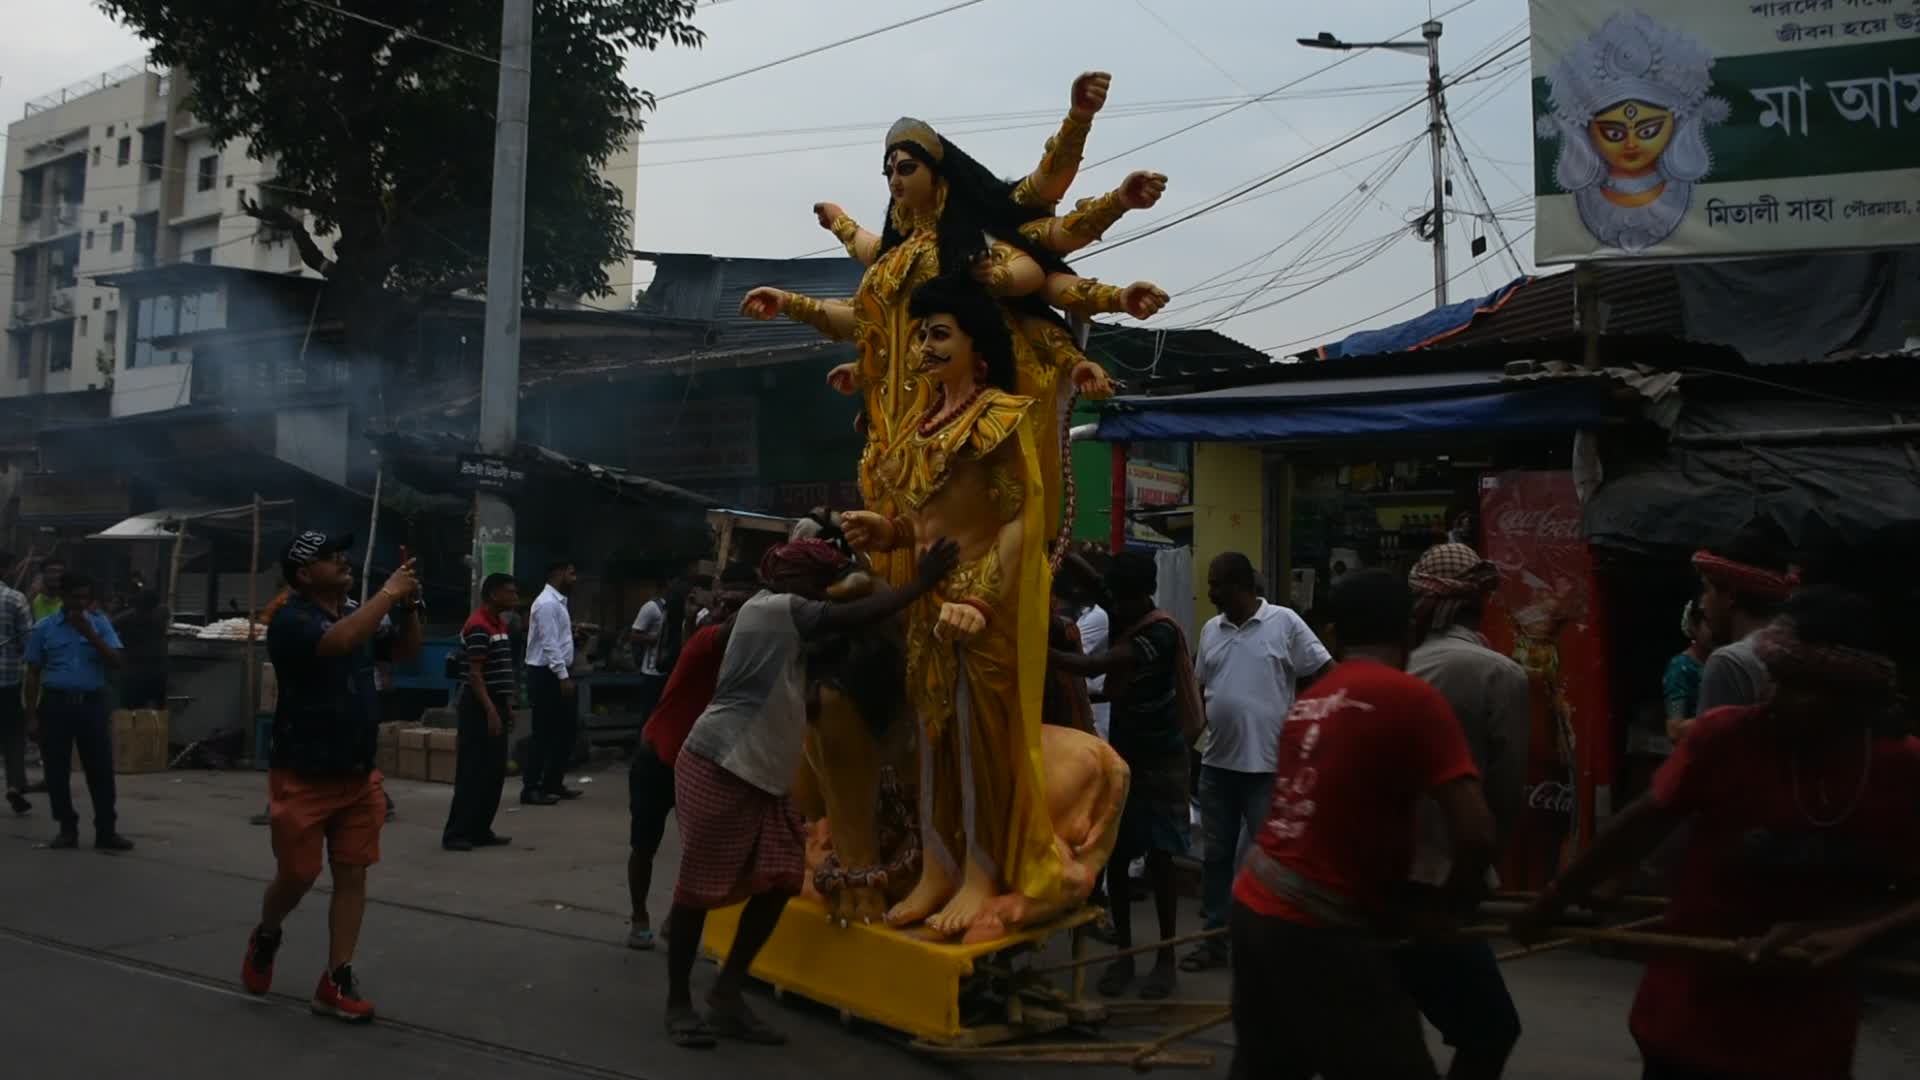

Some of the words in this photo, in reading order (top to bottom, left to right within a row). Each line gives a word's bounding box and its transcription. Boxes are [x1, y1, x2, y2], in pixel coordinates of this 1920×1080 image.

[1776, 21, 1833, 42] জীবন
[1748, 74, 1813, 137] মা
[1706, 194, 1779, 227] মিতালী
[1786, 196, 1834, 222] সাহা
